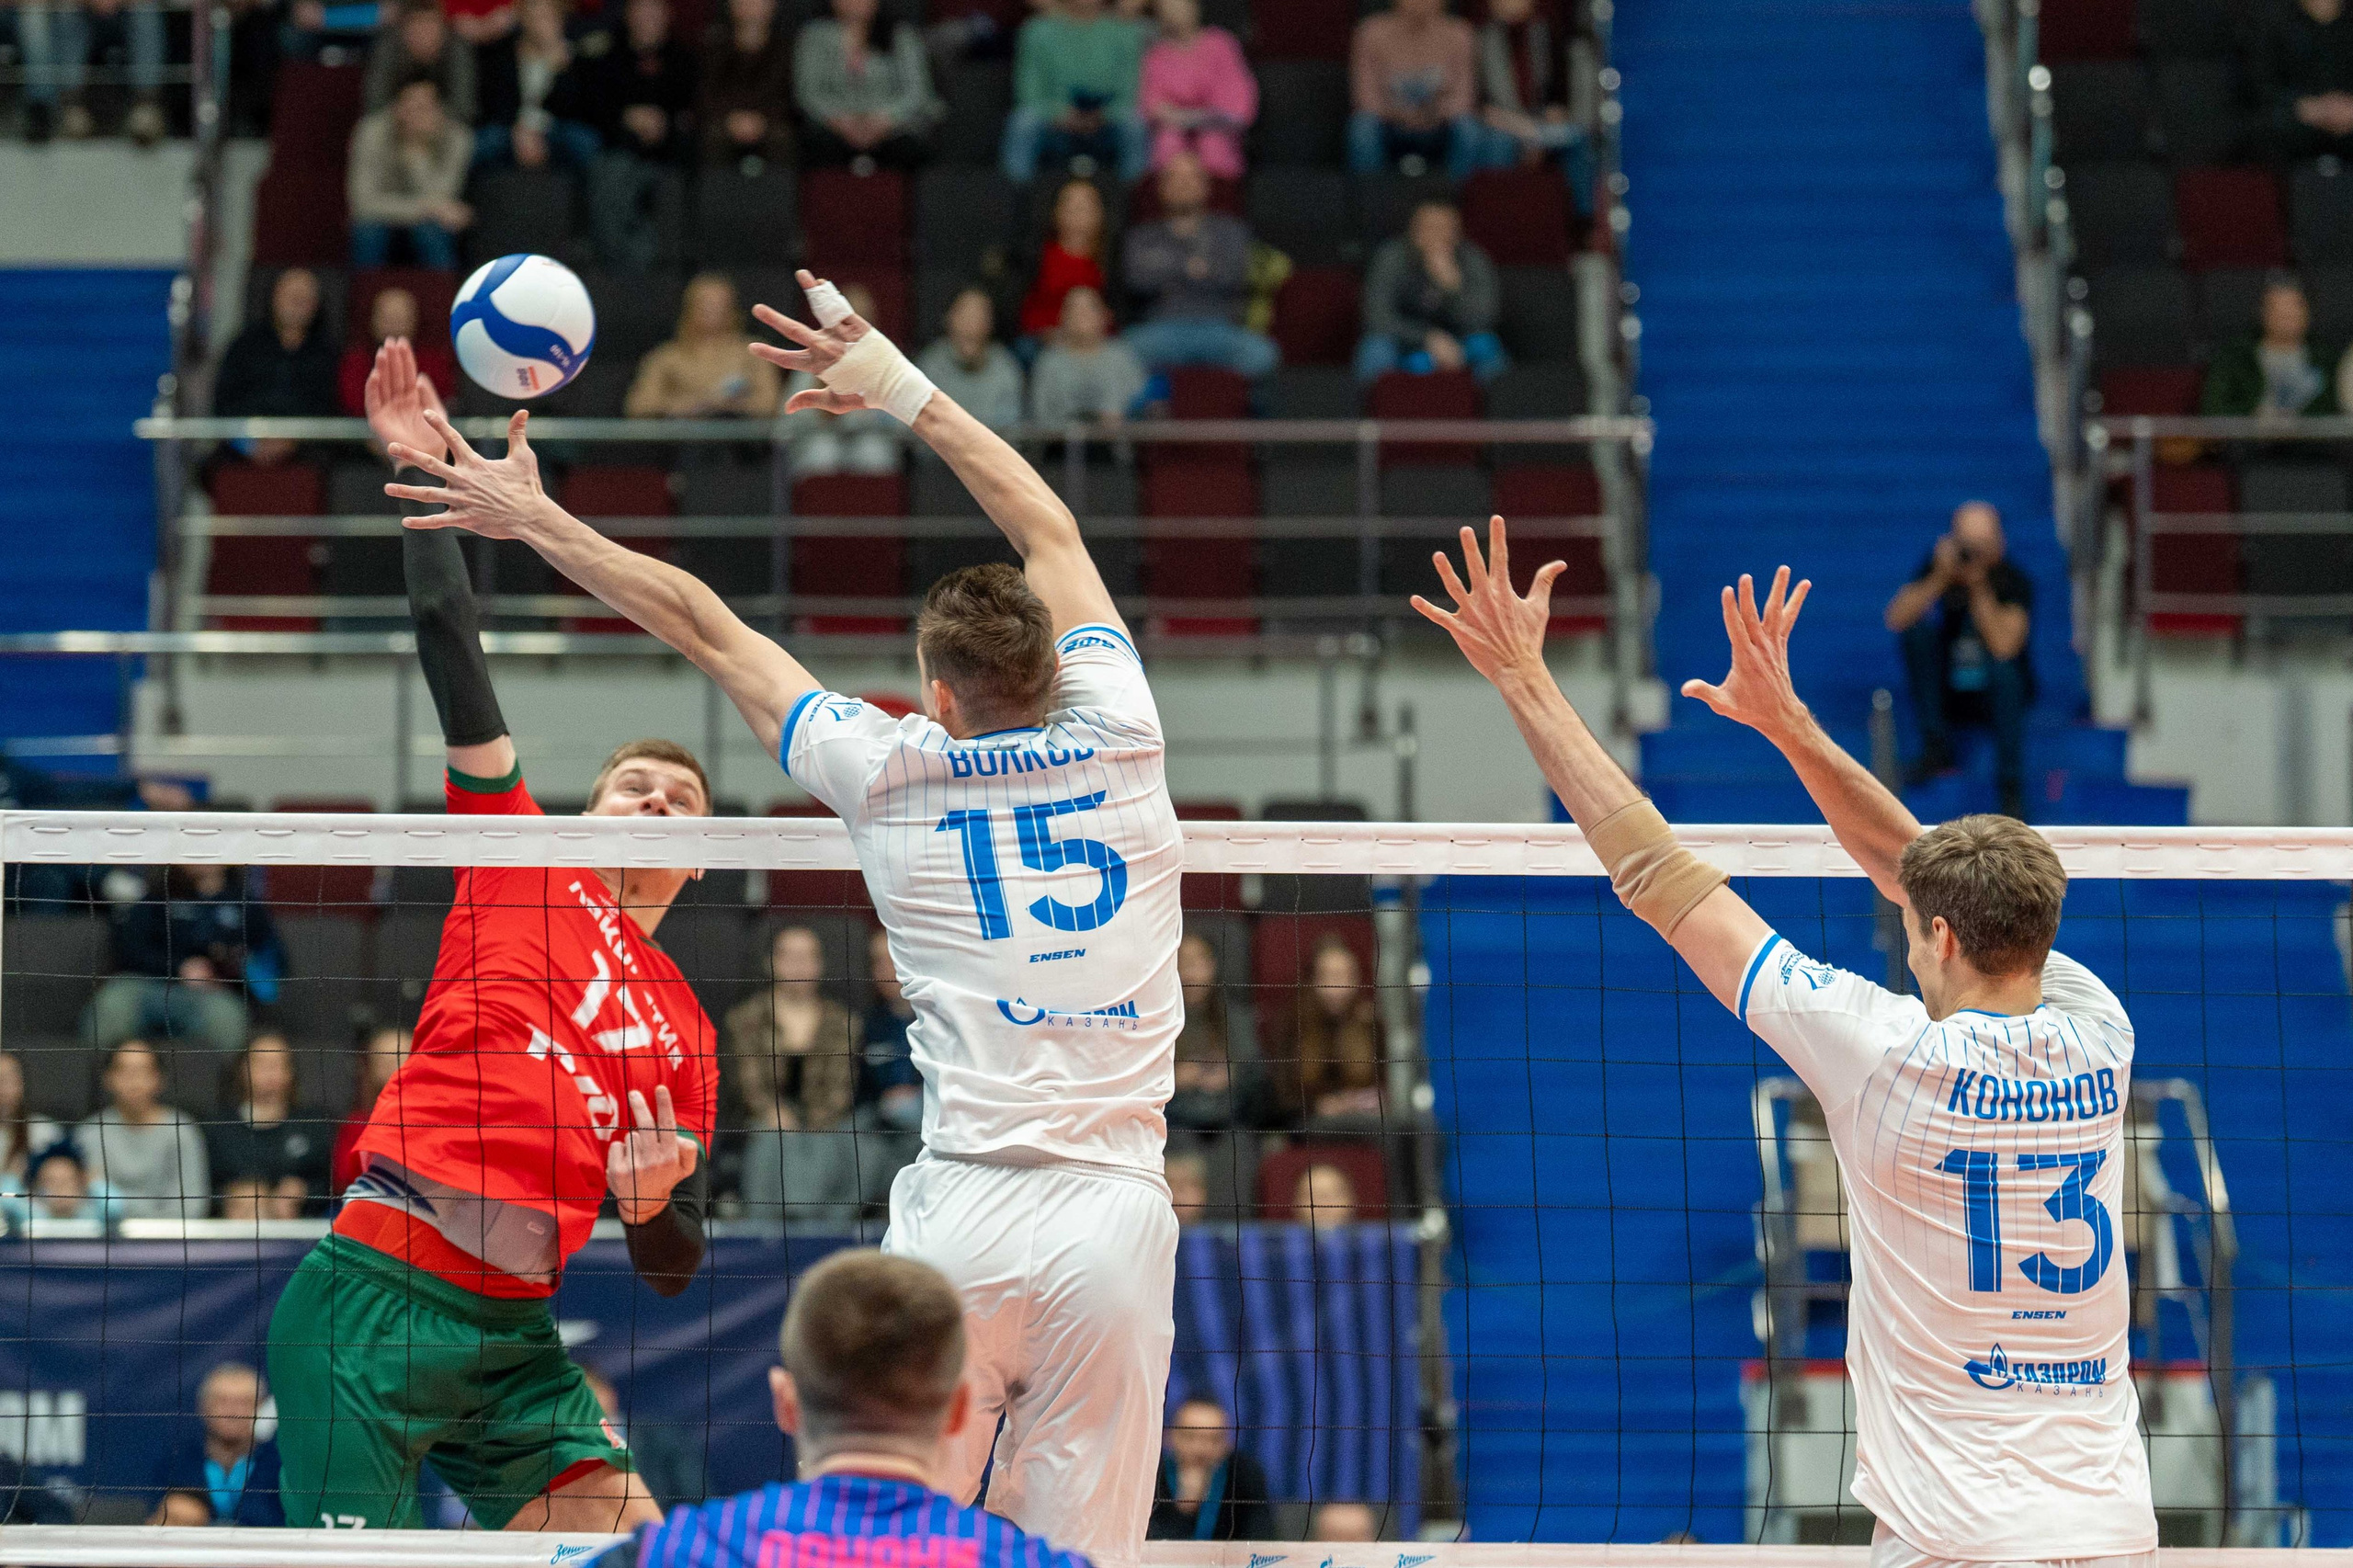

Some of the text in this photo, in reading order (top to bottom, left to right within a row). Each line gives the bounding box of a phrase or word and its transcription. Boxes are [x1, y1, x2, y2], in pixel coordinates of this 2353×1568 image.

[935, 790, 1128, 940] 15
[1029, 949, 1086, 963] ENSEN
[1047, 1017, 1138, 1030] КАЗАНЬ
[1947, 1067, 2120, 1122] КОНОНОВ
[1933, 1149, 2114, 1294] 13
[2011, 1311, 2067, 1320] ENSEN
[2012, 1358, 2107, 1385] ГАЗПРОМ
[2017, 1382, 2104, 1398] КАЗАНЬ
